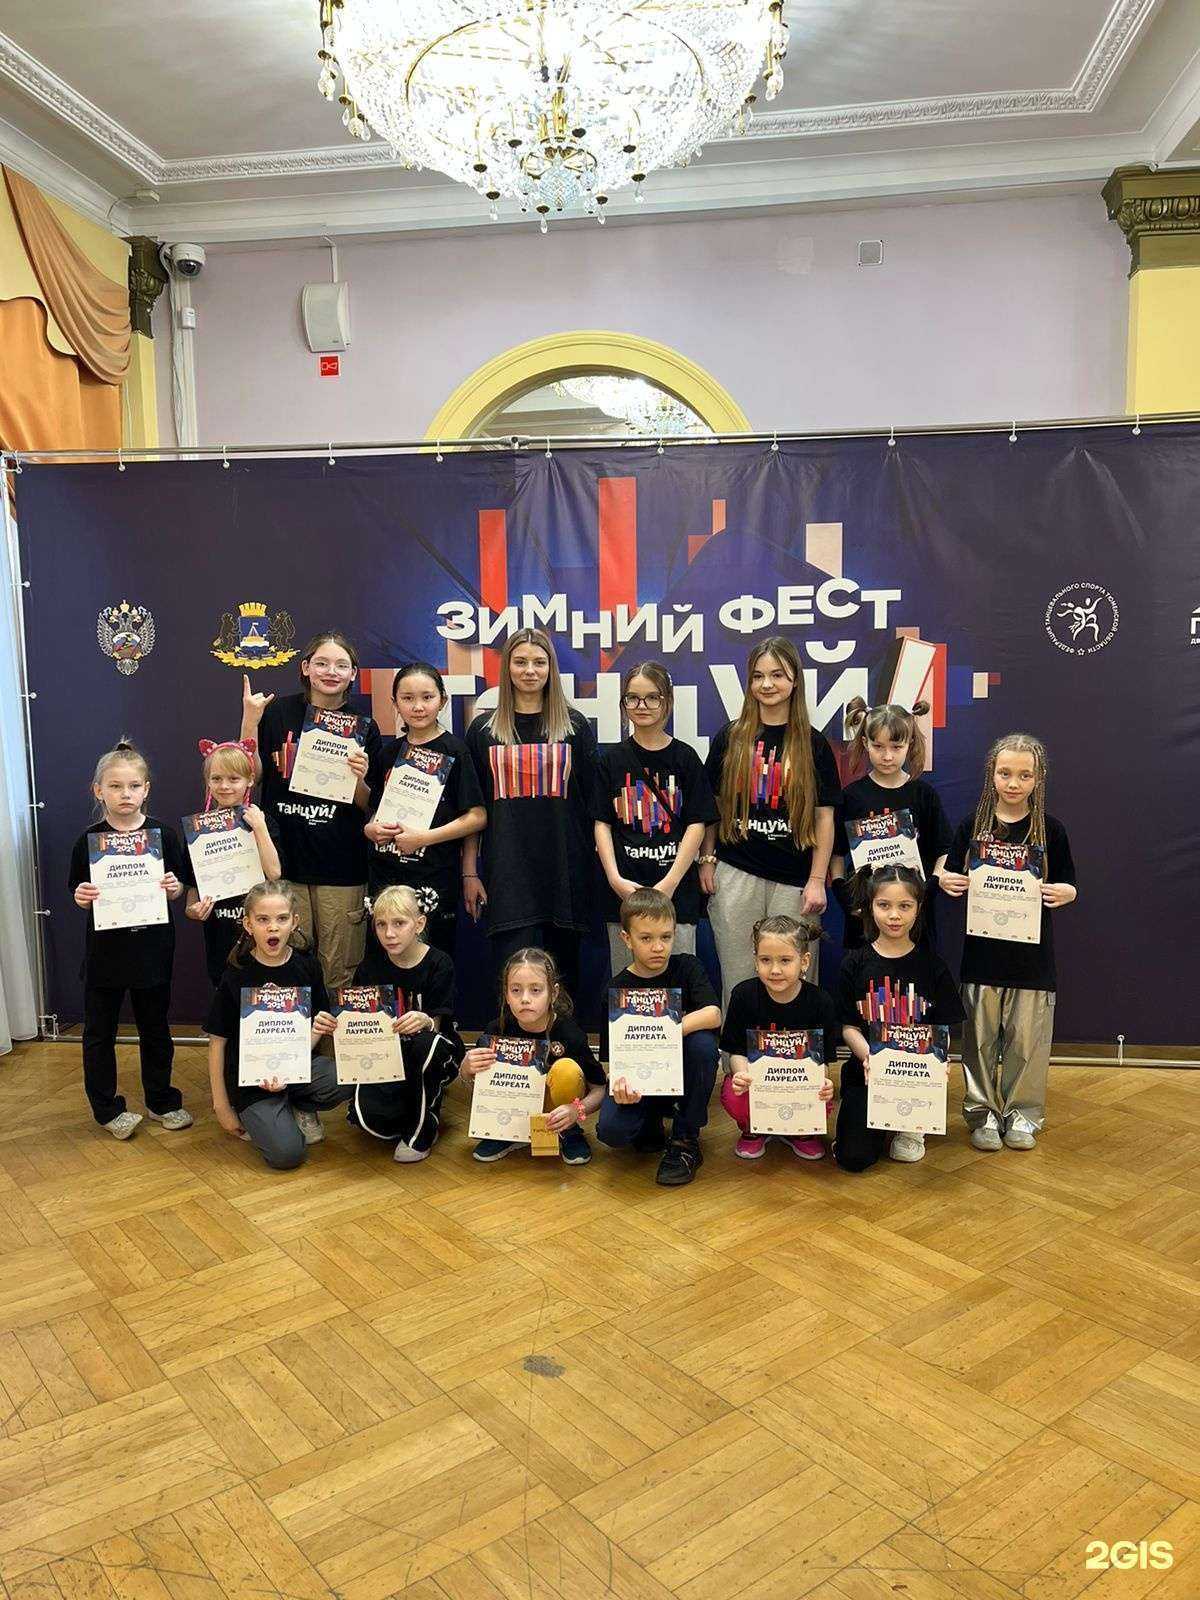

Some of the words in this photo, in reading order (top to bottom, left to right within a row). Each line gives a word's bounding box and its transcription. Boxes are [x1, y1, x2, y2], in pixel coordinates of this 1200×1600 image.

[436, 593, 704, 653] ЗИМНИЙ
[719, 577, 902, 634] ФЕСТ
[315, 738, 348, 750] ДИПЛОМ
[624, 841, 680, 861] танцуй
[868, 843, 901, 856] ДИПЛОМ
[866, 850, 905, 862] ЛАУРЕАТА
[109, 862, 146, 872] ДИПЛОМ
[106, 870, 149, 879] ЛАУРЕАТА
[986, 875, 1023, 885] ДИПЛОМ
[983, 882, 1026, 893] ЛАУРЕАТА
[258, 1020, 294, 1028] ДИПЛОМ
[347, 1020, 380, 1028] ДИПЛОМ
[624, 1033, 667, 1041] ЛАУРЕАТА
[888, 1060, 928, 1069] ДИПЛОМ
[767, 1067, 805, 1075] ДИПЛОМ
[885, 1068, 931, 1079] ЛАУРЕАТА
[493, 1072, 529, 1081] ДИПЛОМ
[764, 1074, 809, 1083] ЛАУРЕАТА
[489, 1079, 531, 1089] ЛАУРЕАТА
